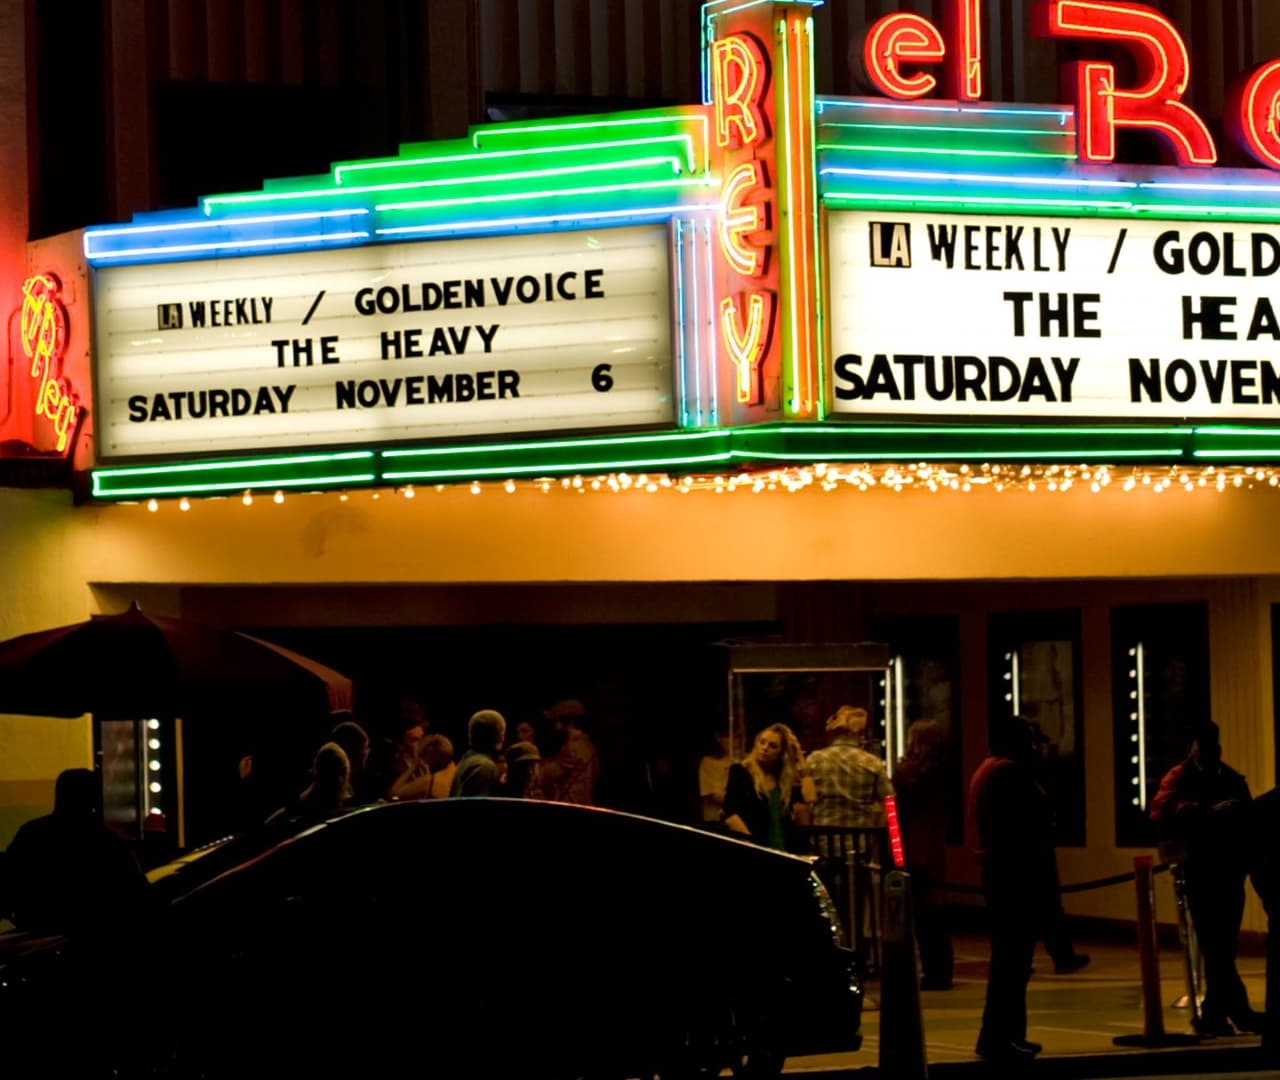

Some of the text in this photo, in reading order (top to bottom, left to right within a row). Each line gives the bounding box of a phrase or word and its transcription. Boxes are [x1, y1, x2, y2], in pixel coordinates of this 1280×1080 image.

[713, 34, 772, 404] REY
[868, 221, 910, 268] LA
[927, 223, 1071, 273] WEEKLY
[157, 303, 183, 330] LA
[189, 296, 273, 328] WEEKLY
[354, 268, 605, 317] GOLDENVOICE
[1003, 291, 1102, 339] THE
[271, 324, 500, 368] THE HEAVY
[128, 363, 615, 423] SATURDAY NOVEMBER 6
[834, 353, 1081, 403] SATURDAY
